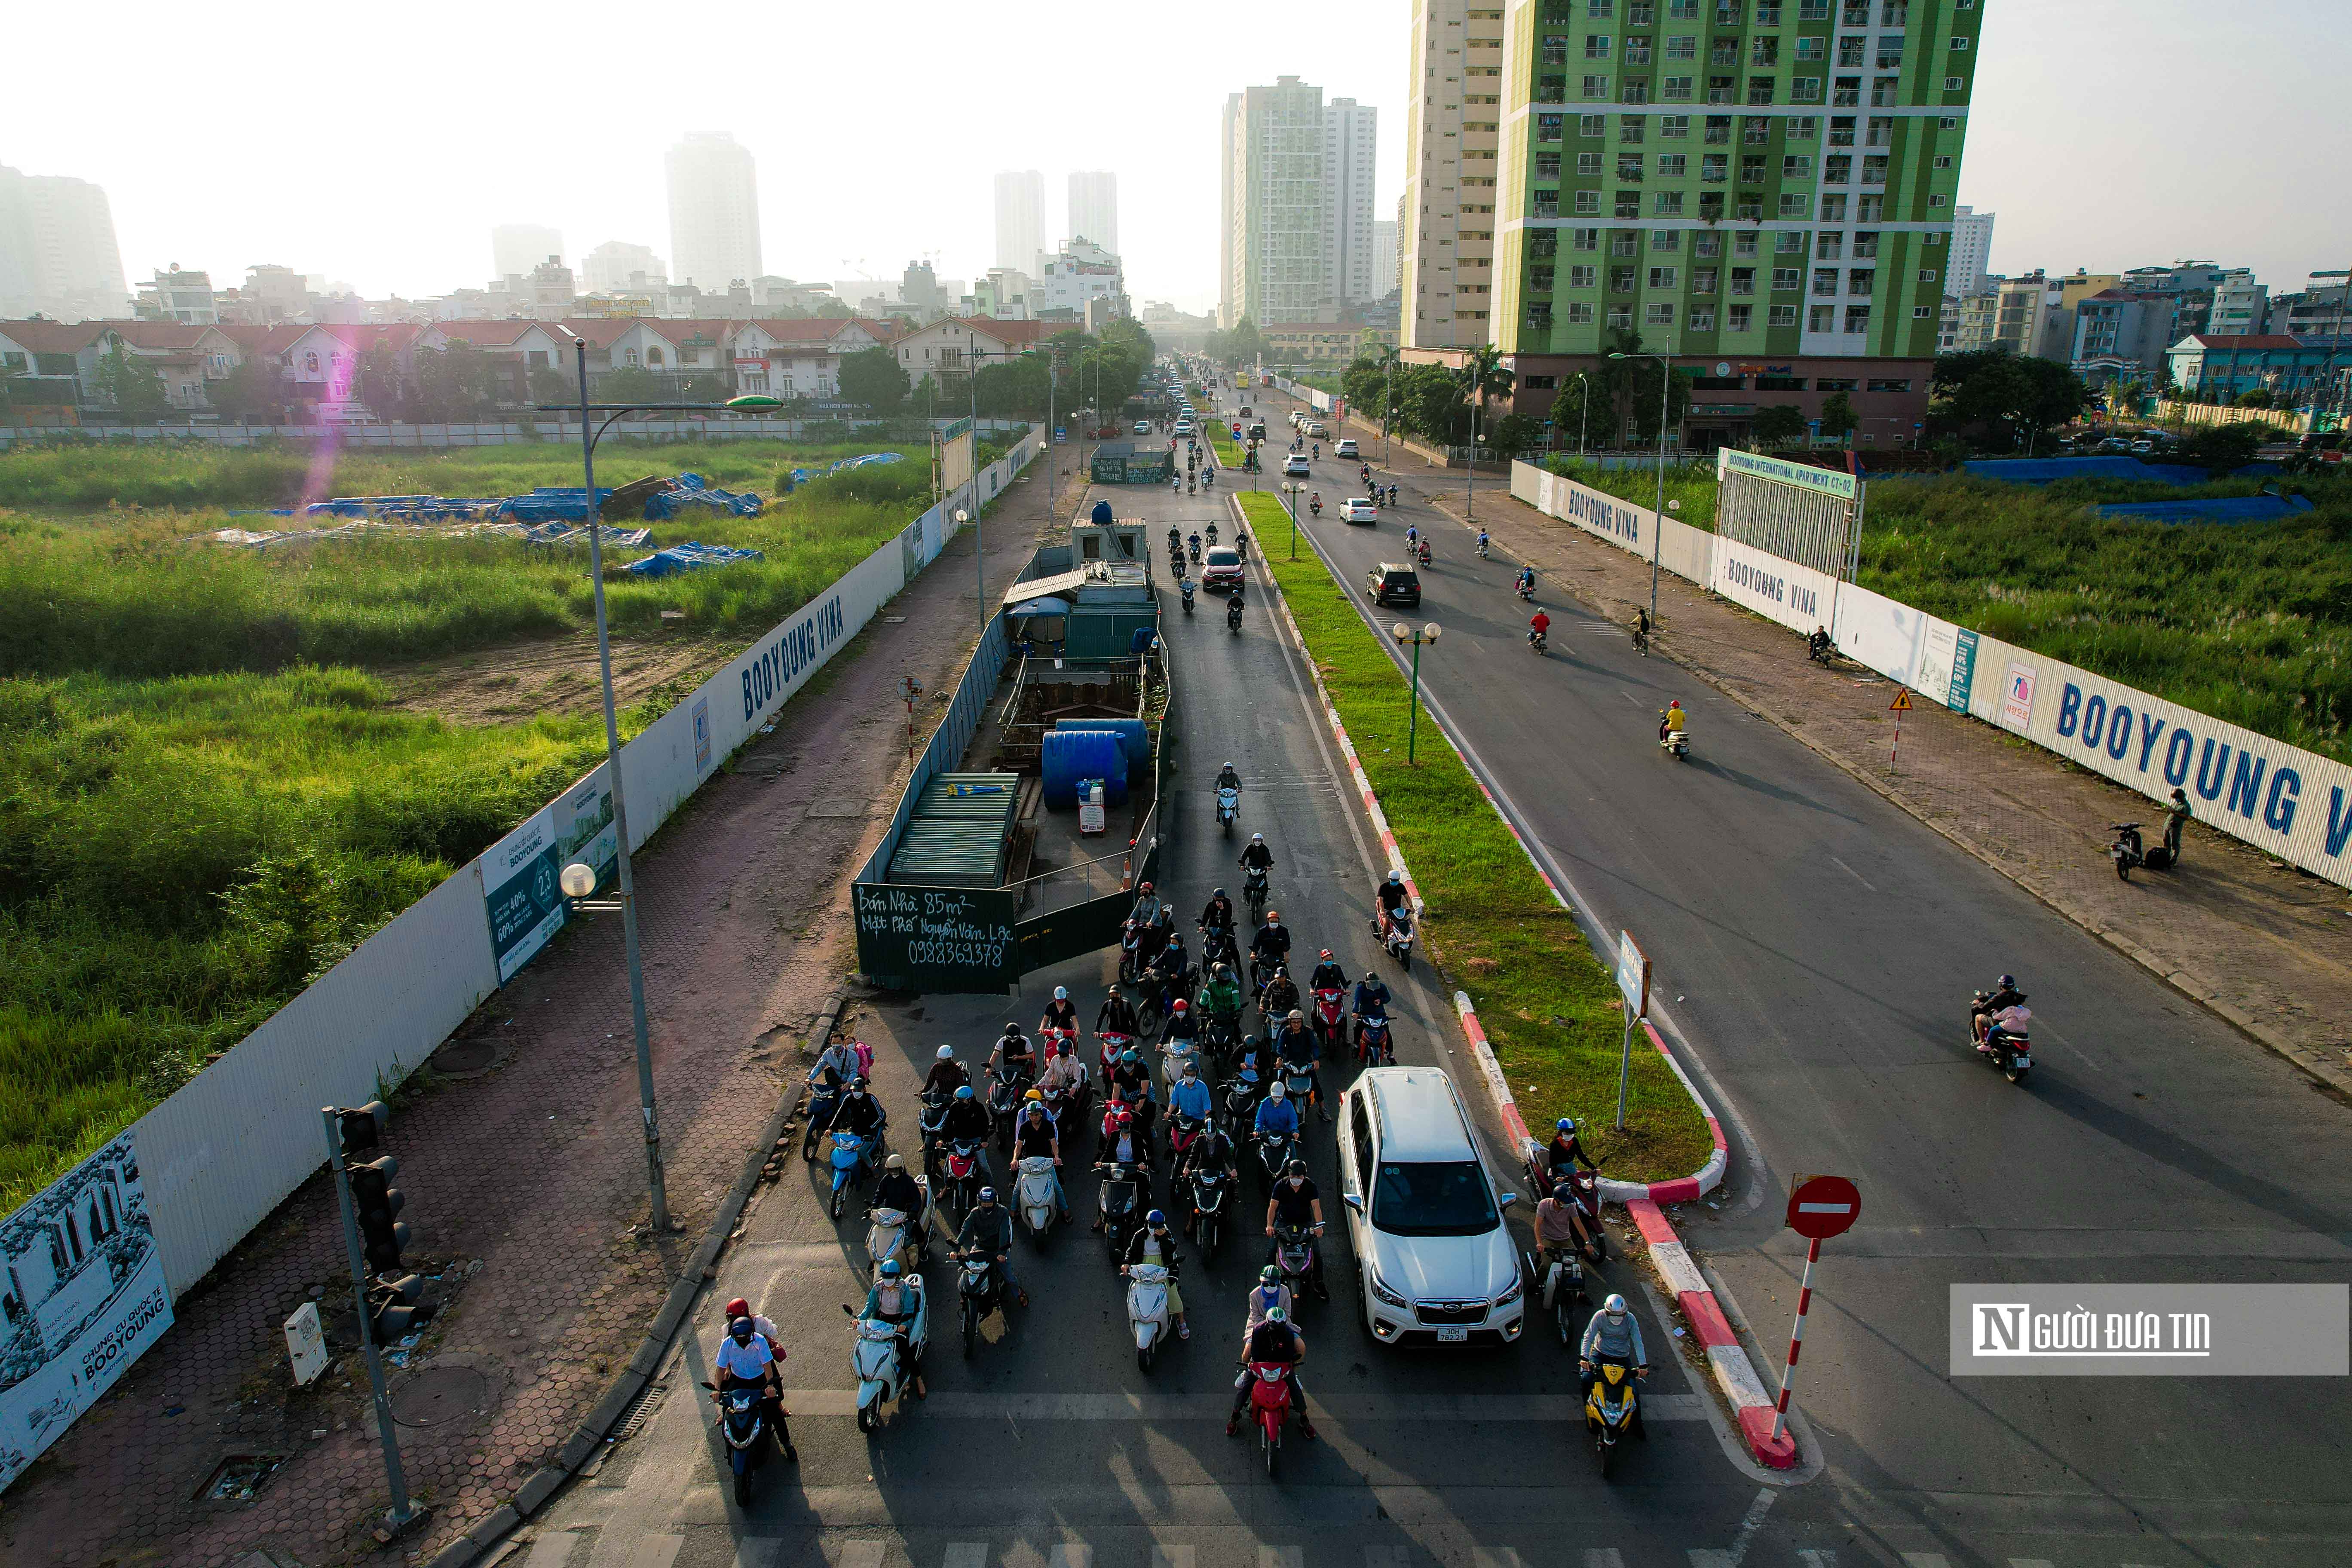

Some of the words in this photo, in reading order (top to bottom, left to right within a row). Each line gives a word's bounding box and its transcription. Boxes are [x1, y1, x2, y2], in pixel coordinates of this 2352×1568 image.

[1730, 454, 1754, 469] BOOYOUNG
[1755, 460, 1794, 479] INTERNATIONAL
[1795, 469, 1829, 487] APARTMENT
[1831, 477, 1851, 492] CT-02
[1569, 489, 1611, 532] BOOYOUNG
[1616, 508, 1637, 544] VINA
[1728, 558, 1783, 602] BOOYOUNG
[1792, 584, 1816, 617] VINA
[742, 618, 815, 722] BOOYOUNG
[817, 594, 843, 651] VINA
[2006, 704, 2028, 720] 사랑으로
[2057, 682, 2301, 836] BOOYOUNG
[509, 836, 542, 868] BOOYOUNG
[510, 889, 526, 910] 40%
[858, 885, 887, 913] Bán
[890, 891, 918, 913] Nhà
[498, 920, 514, 942] 60%
[861, 914, 887, 938] Mặt
[892, 916, 918, 933] Phố
[921, 918, 958, 940] Nguyễn
[959, 924, 986, 940] Văn
[989, 924, 1014, 946] Lộc
[82, 1332, 113, 1365] CHUNG
[129, 1295, 152, 1321] QUỐC
[85, 1298, 165, 1381] BOOYOUNG
